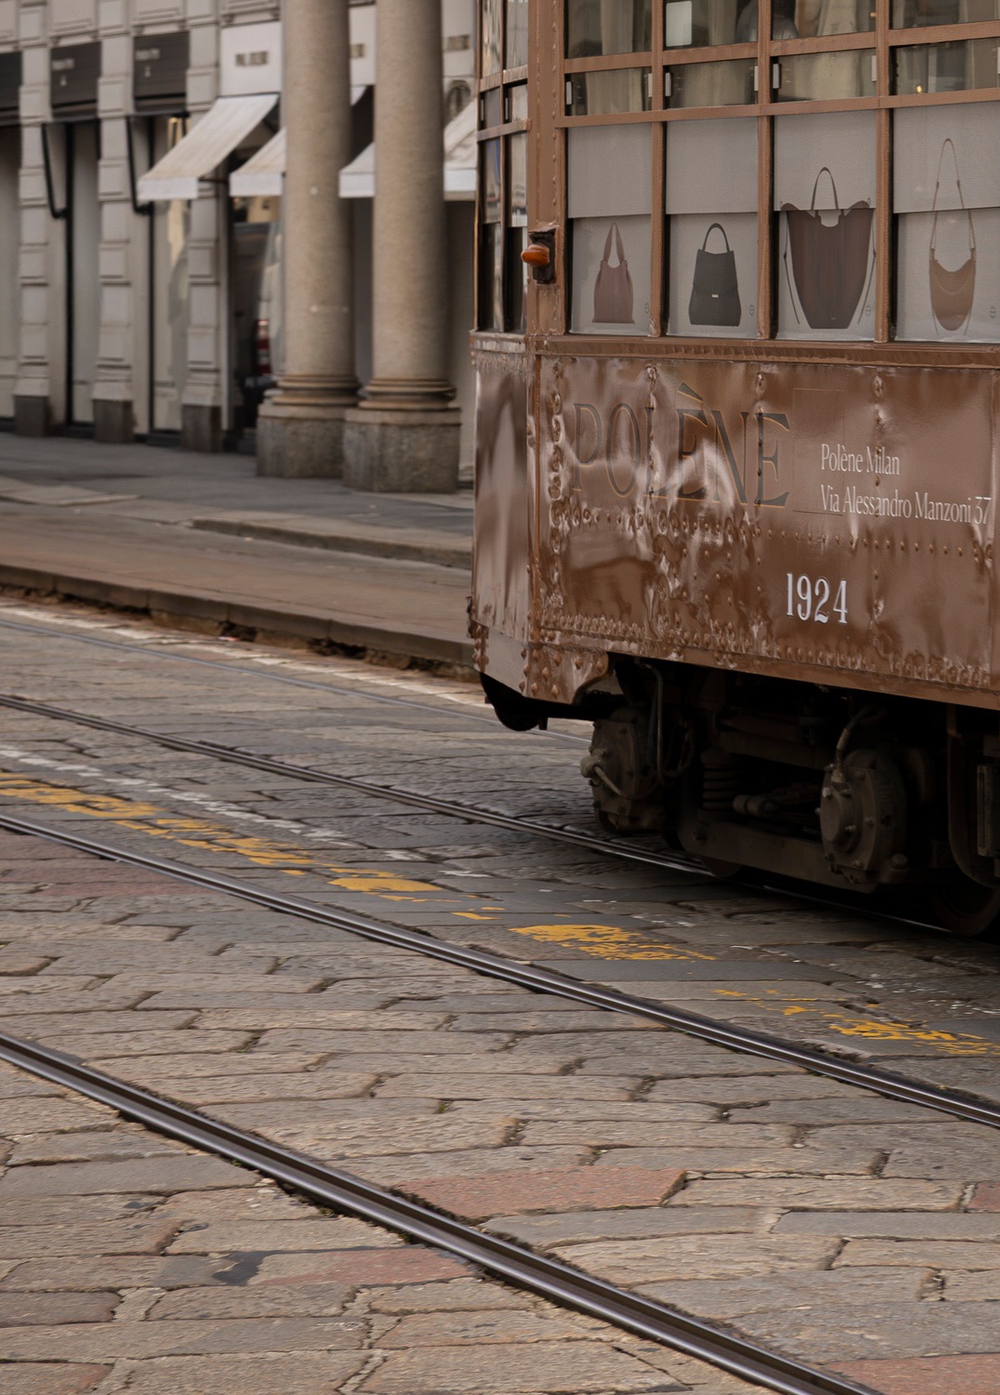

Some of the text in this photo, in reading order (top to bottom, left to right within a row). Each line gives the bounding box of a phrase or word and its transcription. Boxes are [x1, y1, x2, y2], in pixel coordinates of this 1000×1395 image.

[572, 382, 790, 509] POLÈNE
[821, 443, 900, 476] Polène Milan
[820, 484, 993, 525] Via Alessandro Manzoni 37
[786, 572, 848, 624] 1924
